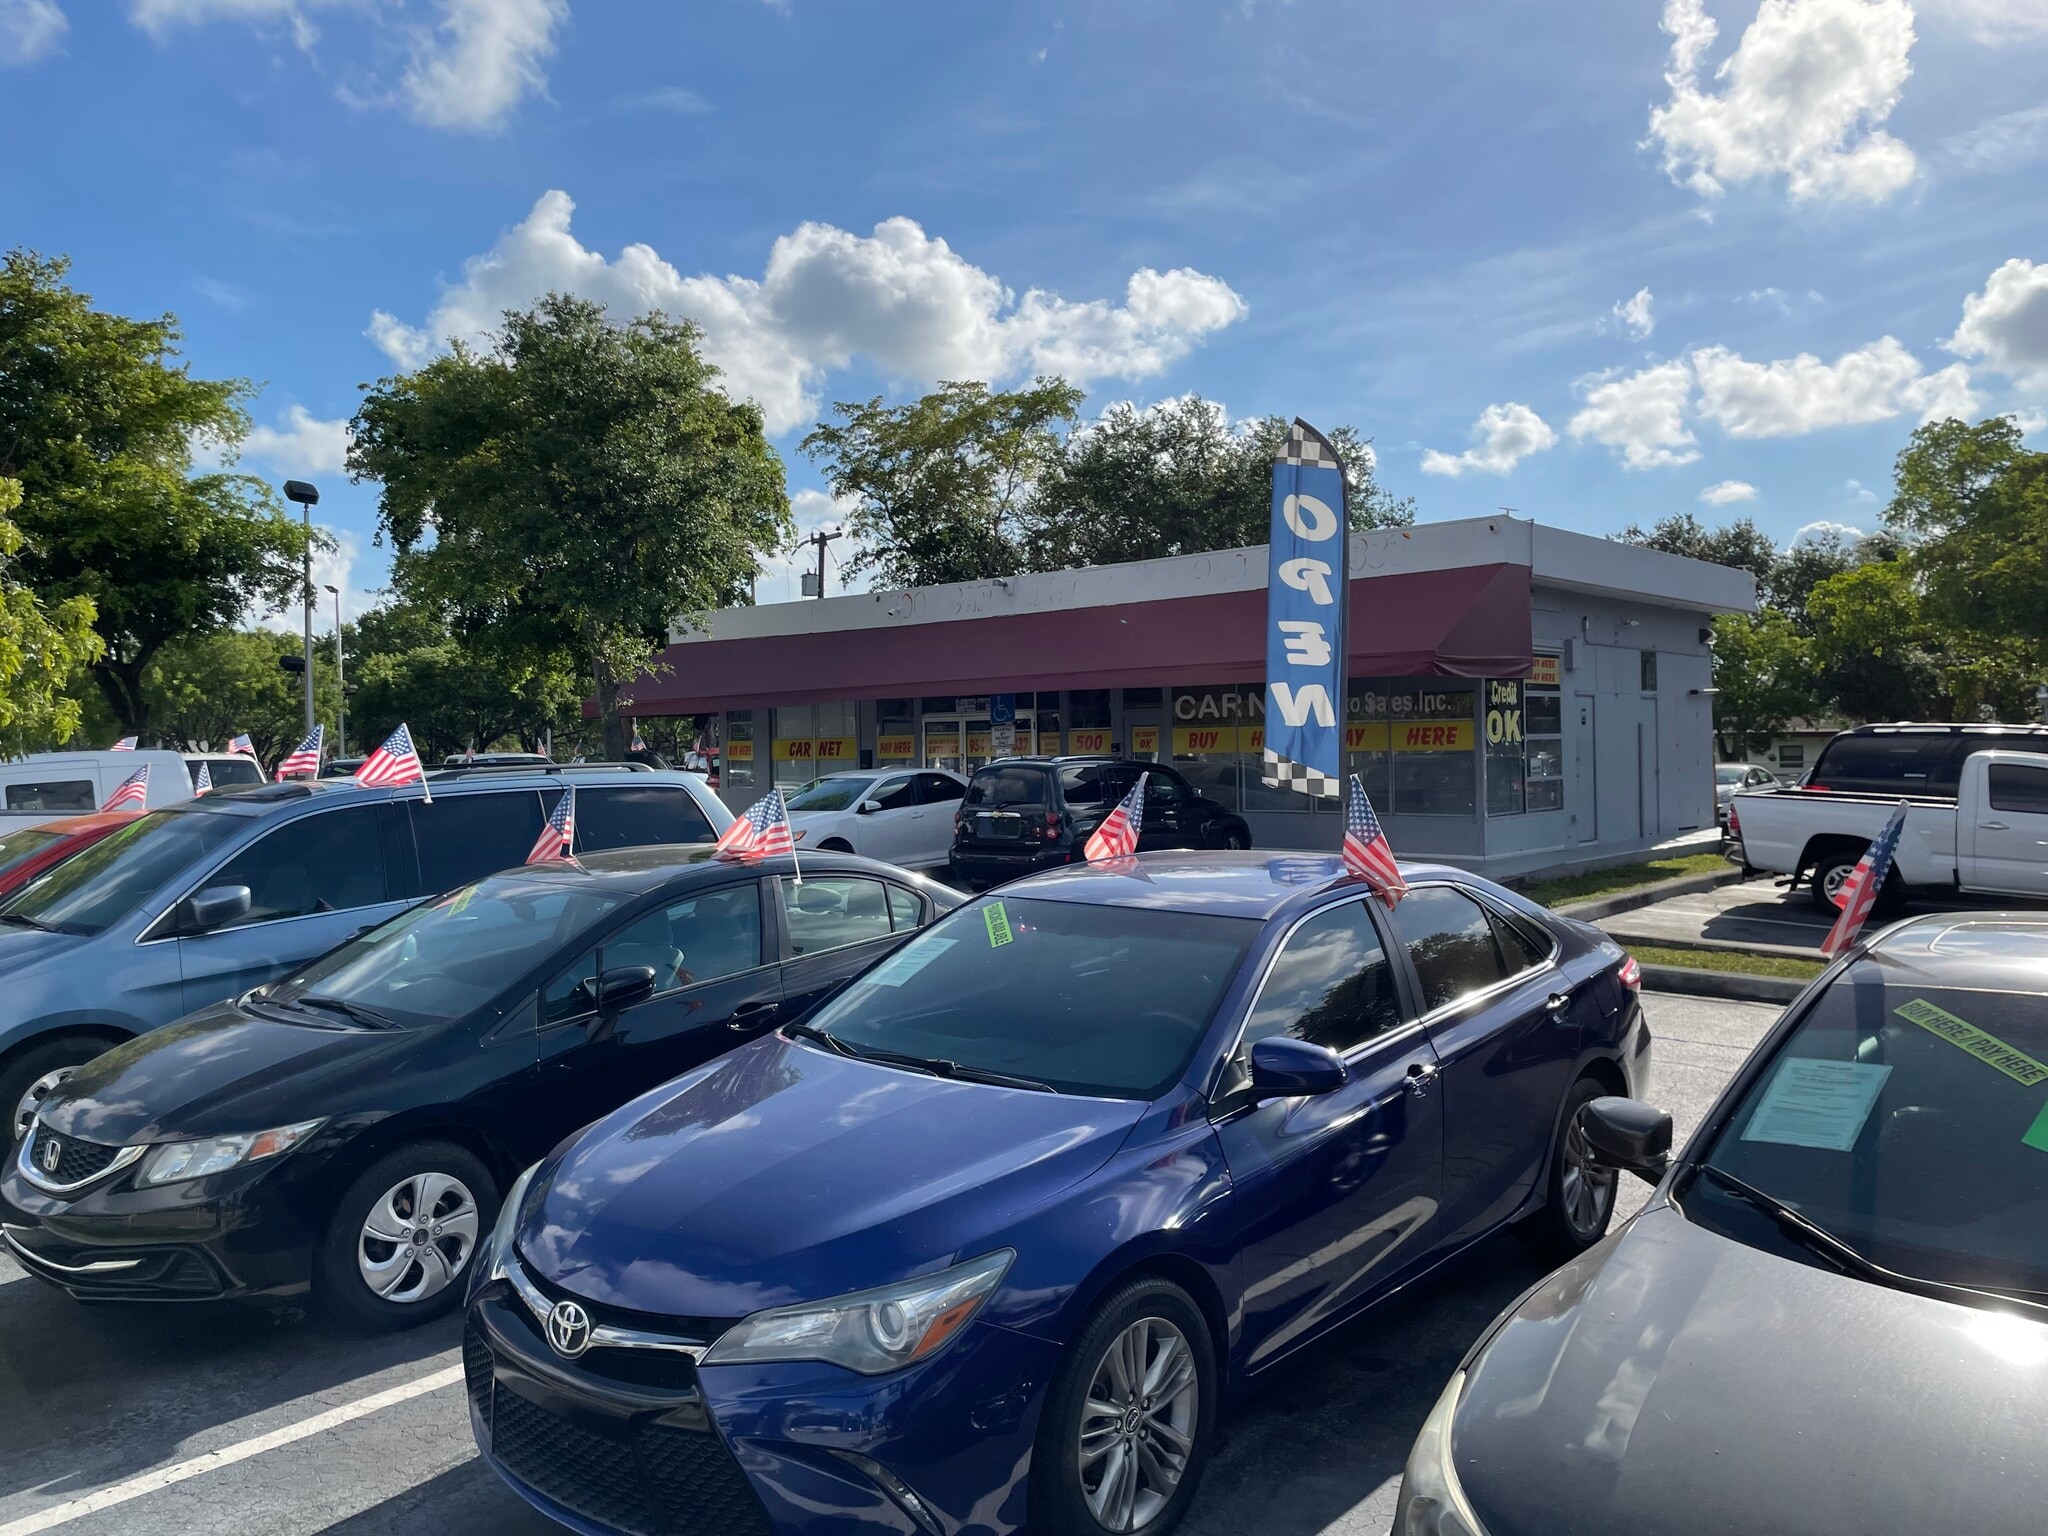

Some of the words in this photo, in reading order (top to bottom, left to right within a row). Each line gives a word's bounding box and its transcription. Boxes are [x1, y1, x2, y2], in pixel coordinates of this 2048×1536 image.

[1542, 659, 1556, 669] HERE
[1542, 673, 1556, 682] HERE
[1491, 680, 1518, 705] Credit
[1076, 734, 1103, 751] 500
[1140, 738, 1153, 749] OK
[1188, 731, 1219, 749] BUY
[1345, 727, 1367, 747] AY
[1406, 726, 1458, 746] HERE
[789, 741, 811, 758] CAR
[818, 740, 843, 757] NET
[880, 742, 893, 754] PAY
[893, 741, 912, 754] HERE
[1902, 1003, 1935, 1020] BUY
[1925, 1014, 1970, 1041] HERE
[1967, 1034, 2006, 1060] PAY
[1993, 1052, 2047, 1083] HERE
